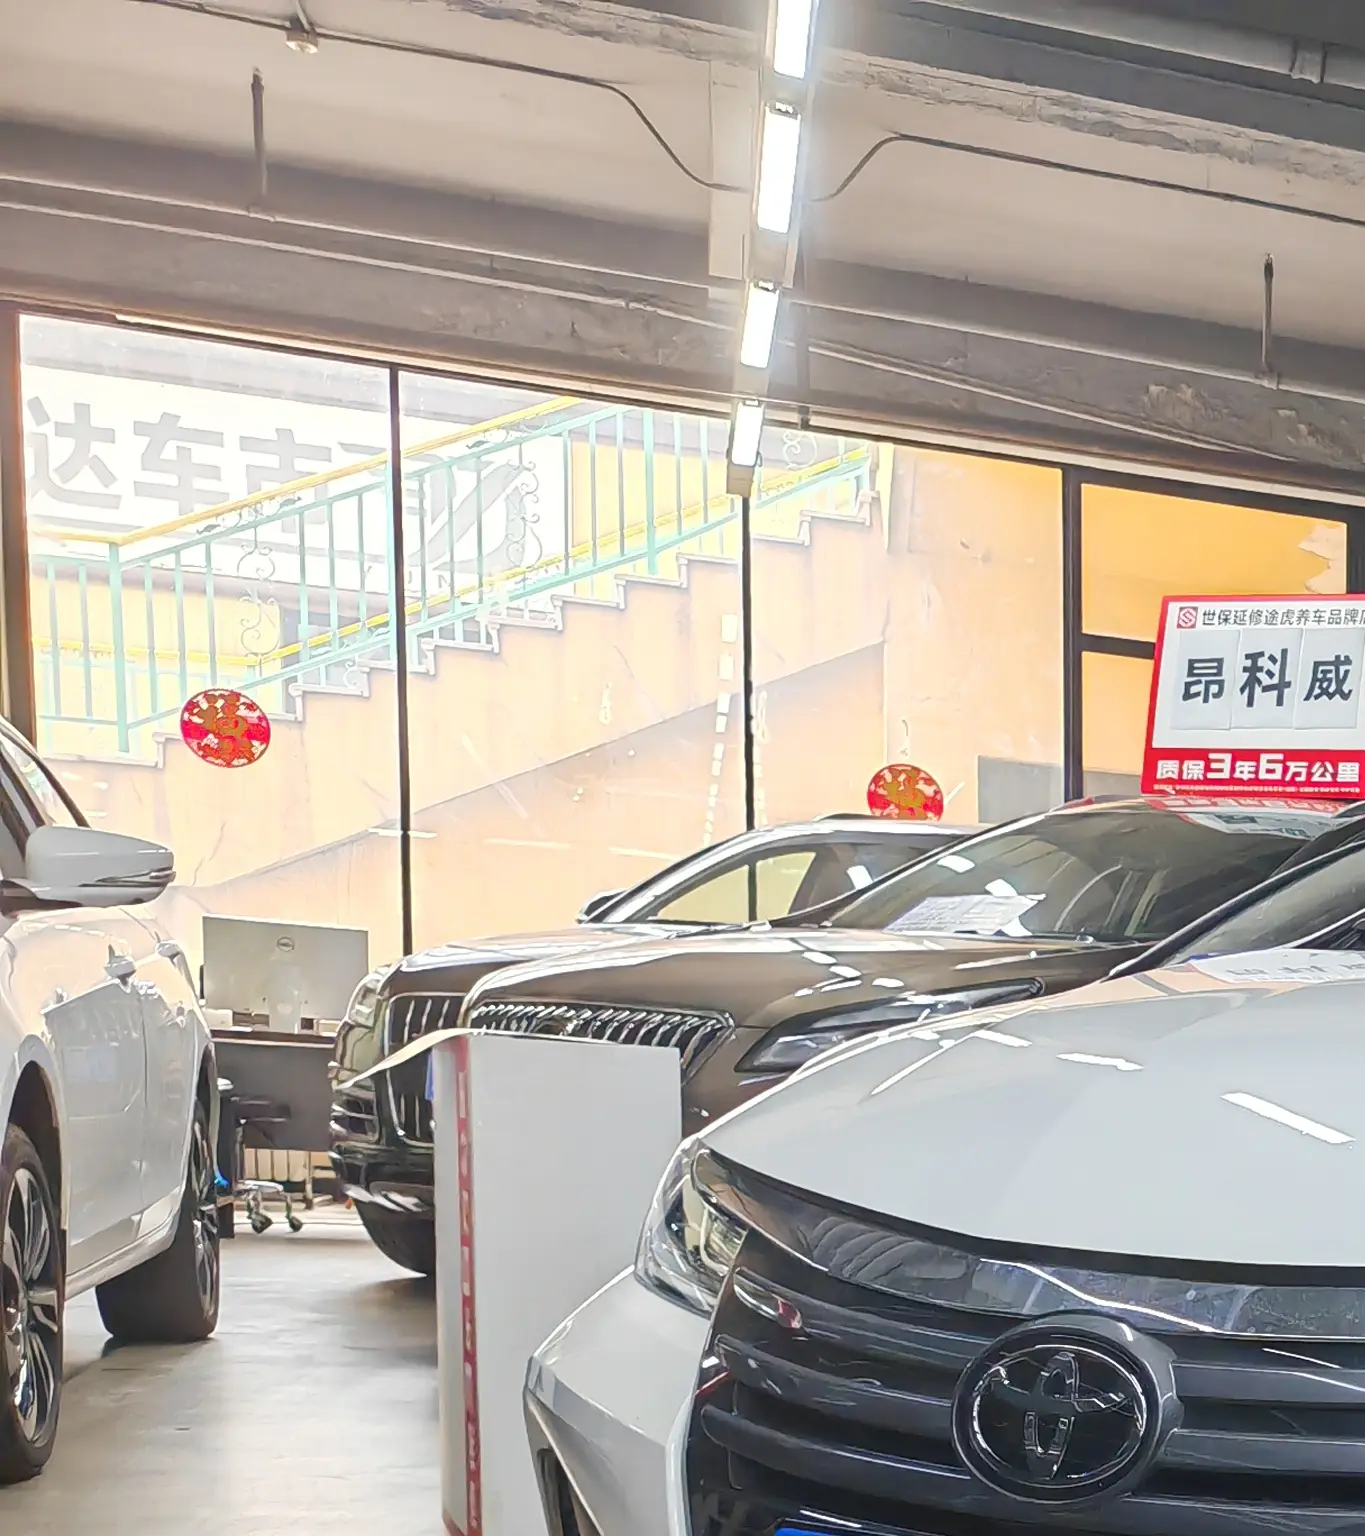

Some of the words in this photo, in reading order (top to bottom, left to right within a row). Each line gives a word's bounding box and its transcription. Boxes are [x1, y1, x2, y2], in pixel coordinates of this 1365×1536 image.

[1181, 648, 1354, 708] 昂科威
[1155, 752, 1361, 783] 质保3年6万公里
